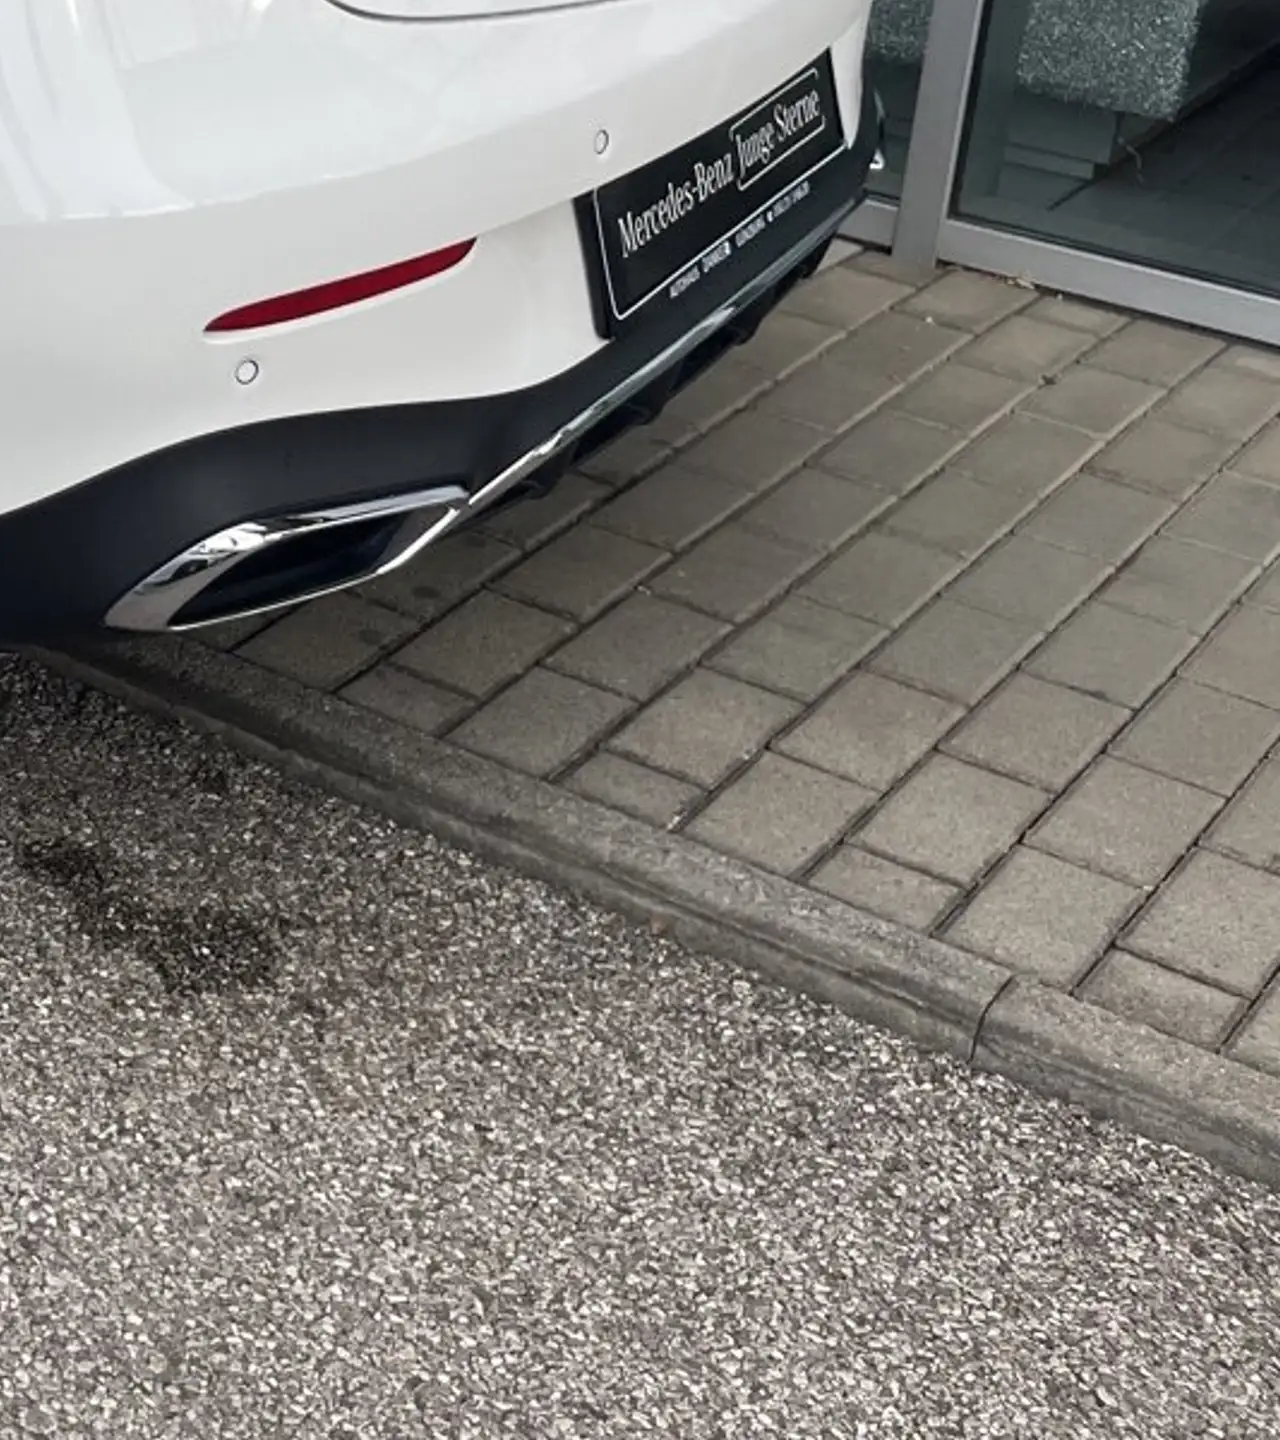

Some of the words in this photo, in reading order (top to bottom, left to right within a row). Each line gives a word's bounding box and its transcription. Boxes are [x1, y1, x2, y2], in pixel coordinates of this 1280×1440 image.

[618, 153, 734, 258] Mercedes-Benz
[735, 124, 775, 178] Junge
[773, 90, 820, 142] Sterne
